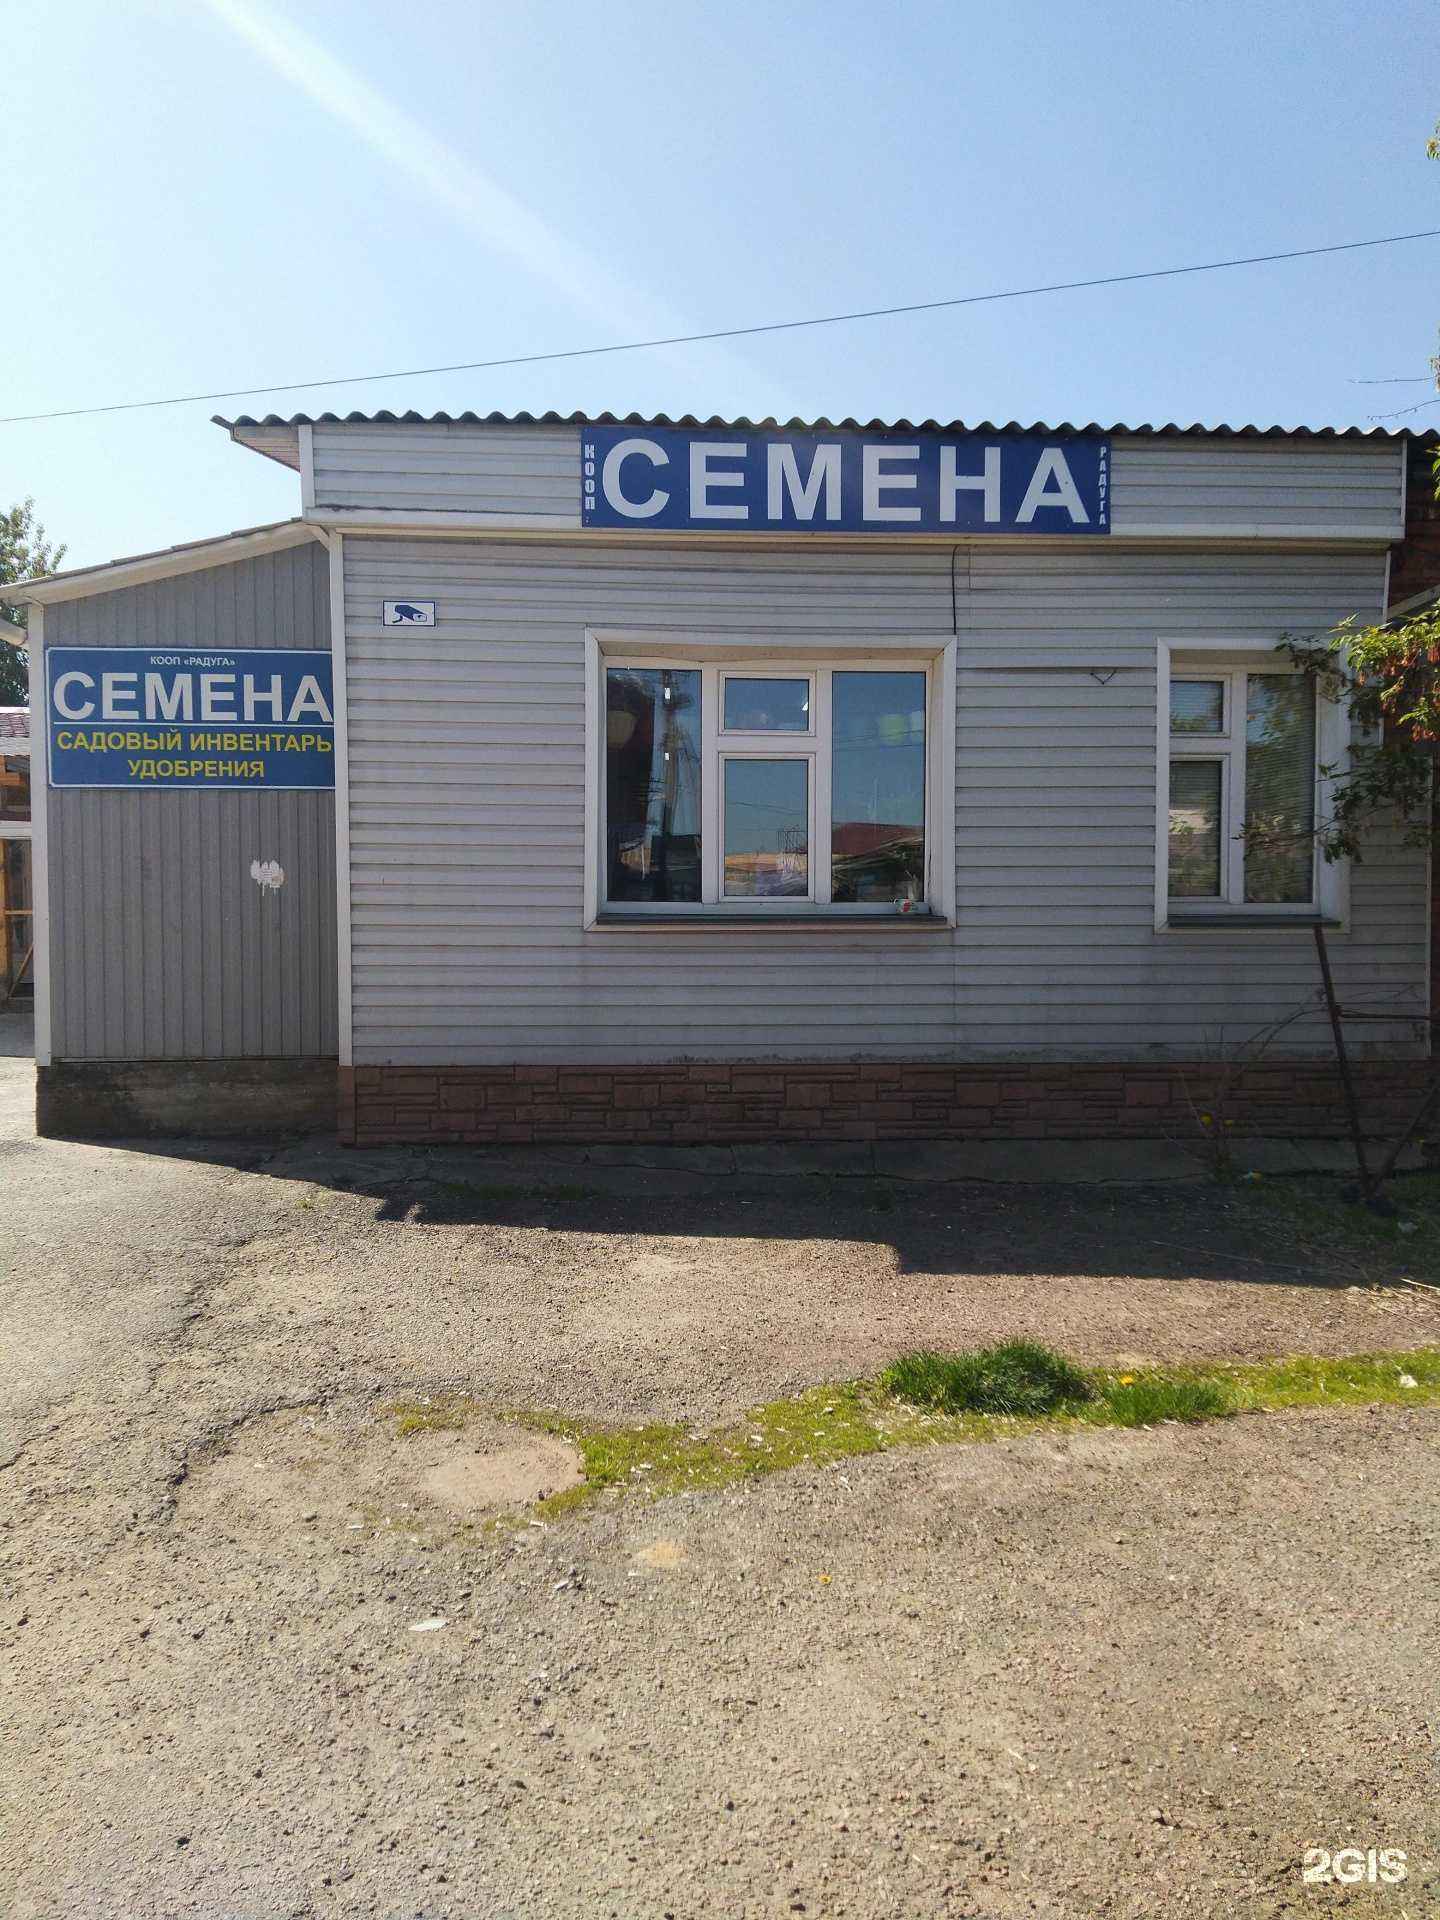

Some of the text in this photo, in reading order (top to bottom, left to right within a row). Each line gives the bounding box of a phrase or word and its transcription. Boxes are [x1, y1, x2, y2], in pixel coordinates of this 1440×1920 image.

[584, 444, 596, 510] КООП
[602, 438, 1090, 523] СЕМЕНА
[1098, 446, 1107, 525] РАДУГА
[150, 655, 236, 668] КООП «РАДУГА»
[53, 671, 334, 723] СЕМЕНА
[57, 729, 332, 753] САДОВЫЙ ИНВЕНТАРЬ
[127, 759, 265, 779] УДОБРЕНИЯ
